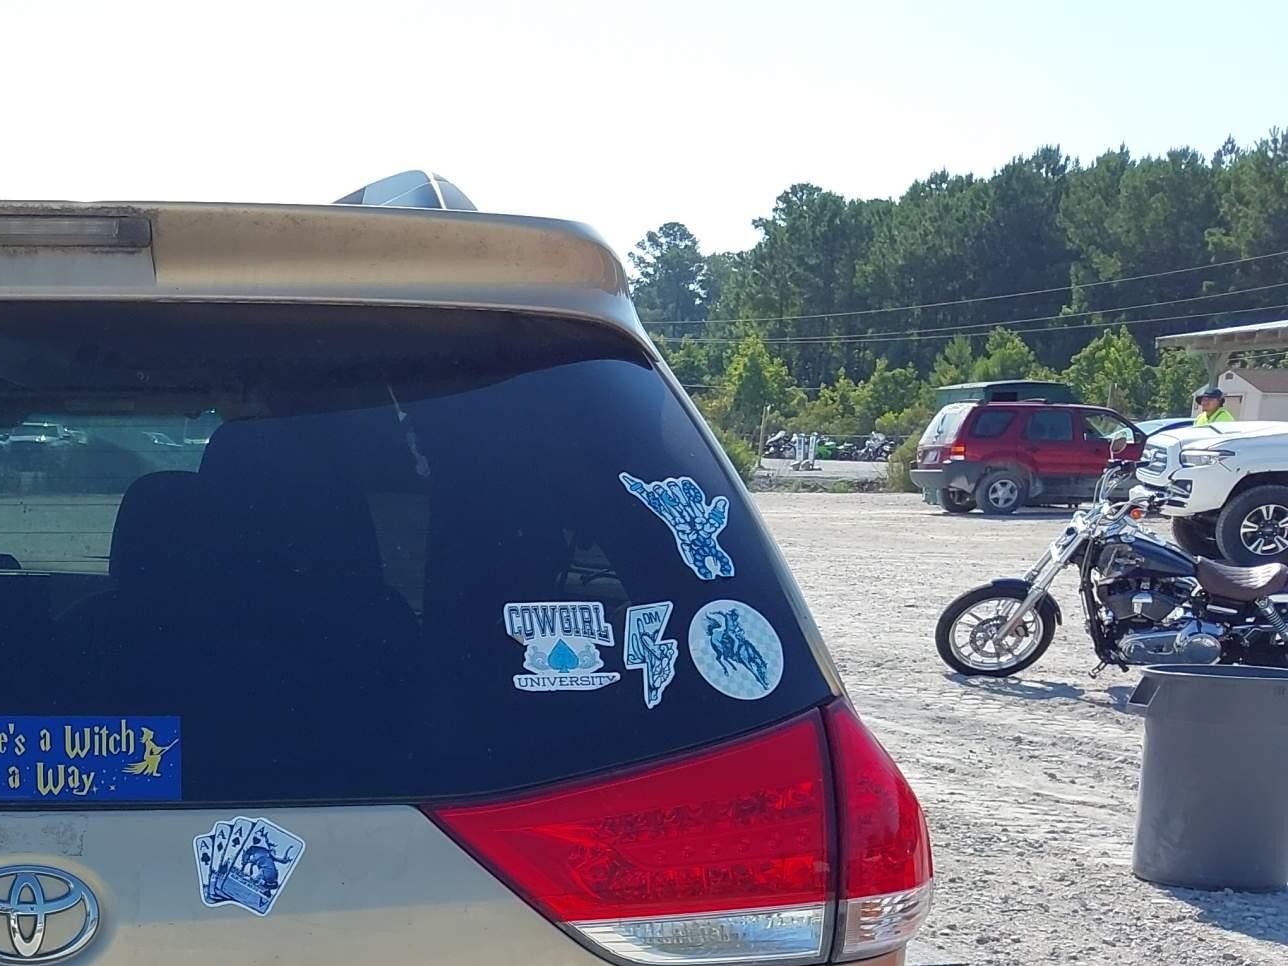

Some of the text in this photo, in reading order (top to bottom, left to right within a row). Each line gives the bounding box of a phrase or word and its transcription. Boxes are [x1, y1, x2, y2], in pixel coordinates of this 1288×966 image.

[508, 605, 610, 641] COWGIRL
[644, 612, 661, 625] DM
[39, 729, 51, 752] a
[64, 719, 135, 759] Witch
[8, 766, 20, 790] a
[36, 762, 94, 796] Way
